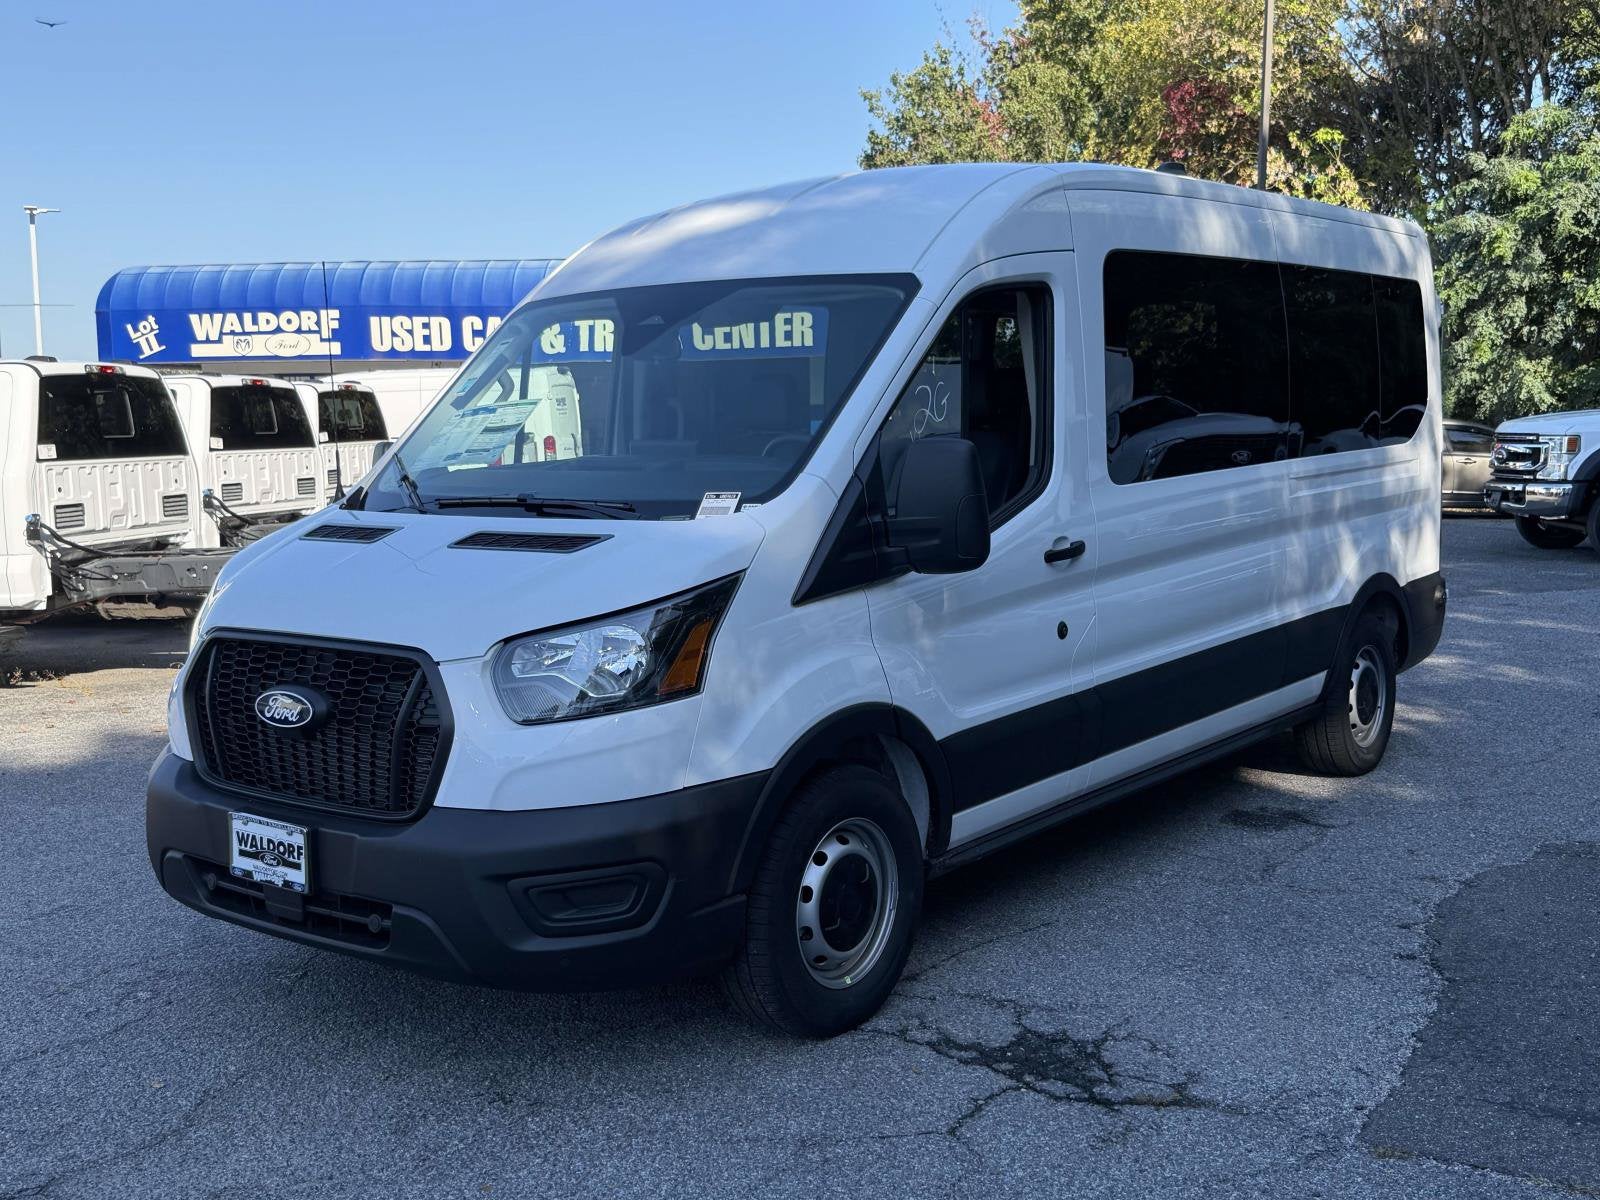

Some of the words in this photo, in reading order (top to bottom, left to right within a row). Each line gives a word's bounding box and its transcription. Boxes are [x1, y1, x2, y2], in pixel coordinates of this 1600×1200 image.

[126, 315, 159, 338] Lot
[189, 309, 340, 341] WALDORF
[369, 315, 452, 352] USED
[541, 323, 566, 354] &
[273, 340, 300, 350] Ford
[264, 695, 300, 722] Ford
[236, 830, 304, 861] WALDORF
